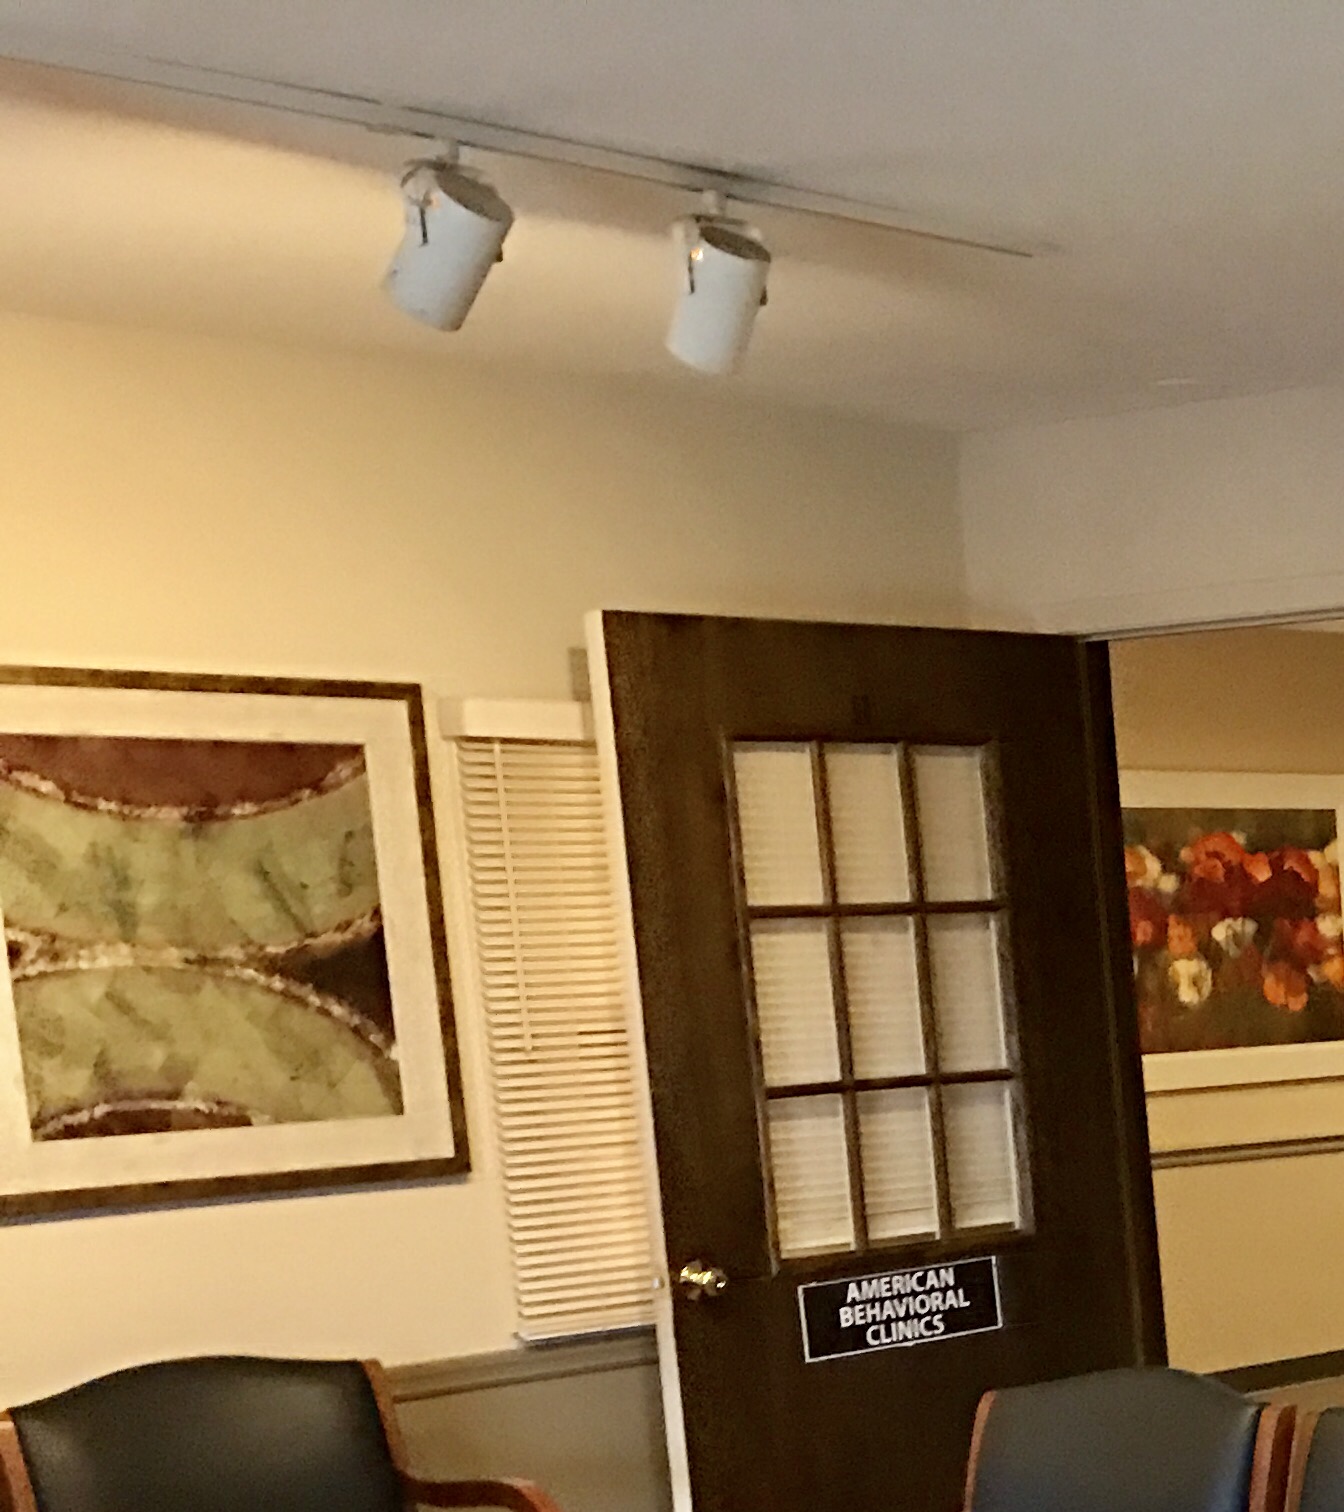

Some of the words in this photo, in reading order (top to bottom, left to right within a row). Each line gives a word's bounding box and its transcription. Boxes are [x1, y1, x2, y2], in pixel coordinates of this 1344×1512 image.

[846, 1267, 955, 1303] AMERICAN
[839, 1288, 971, 1328] BEHAVIORAL
[866, 1314, 945, 1346] CLINICS
